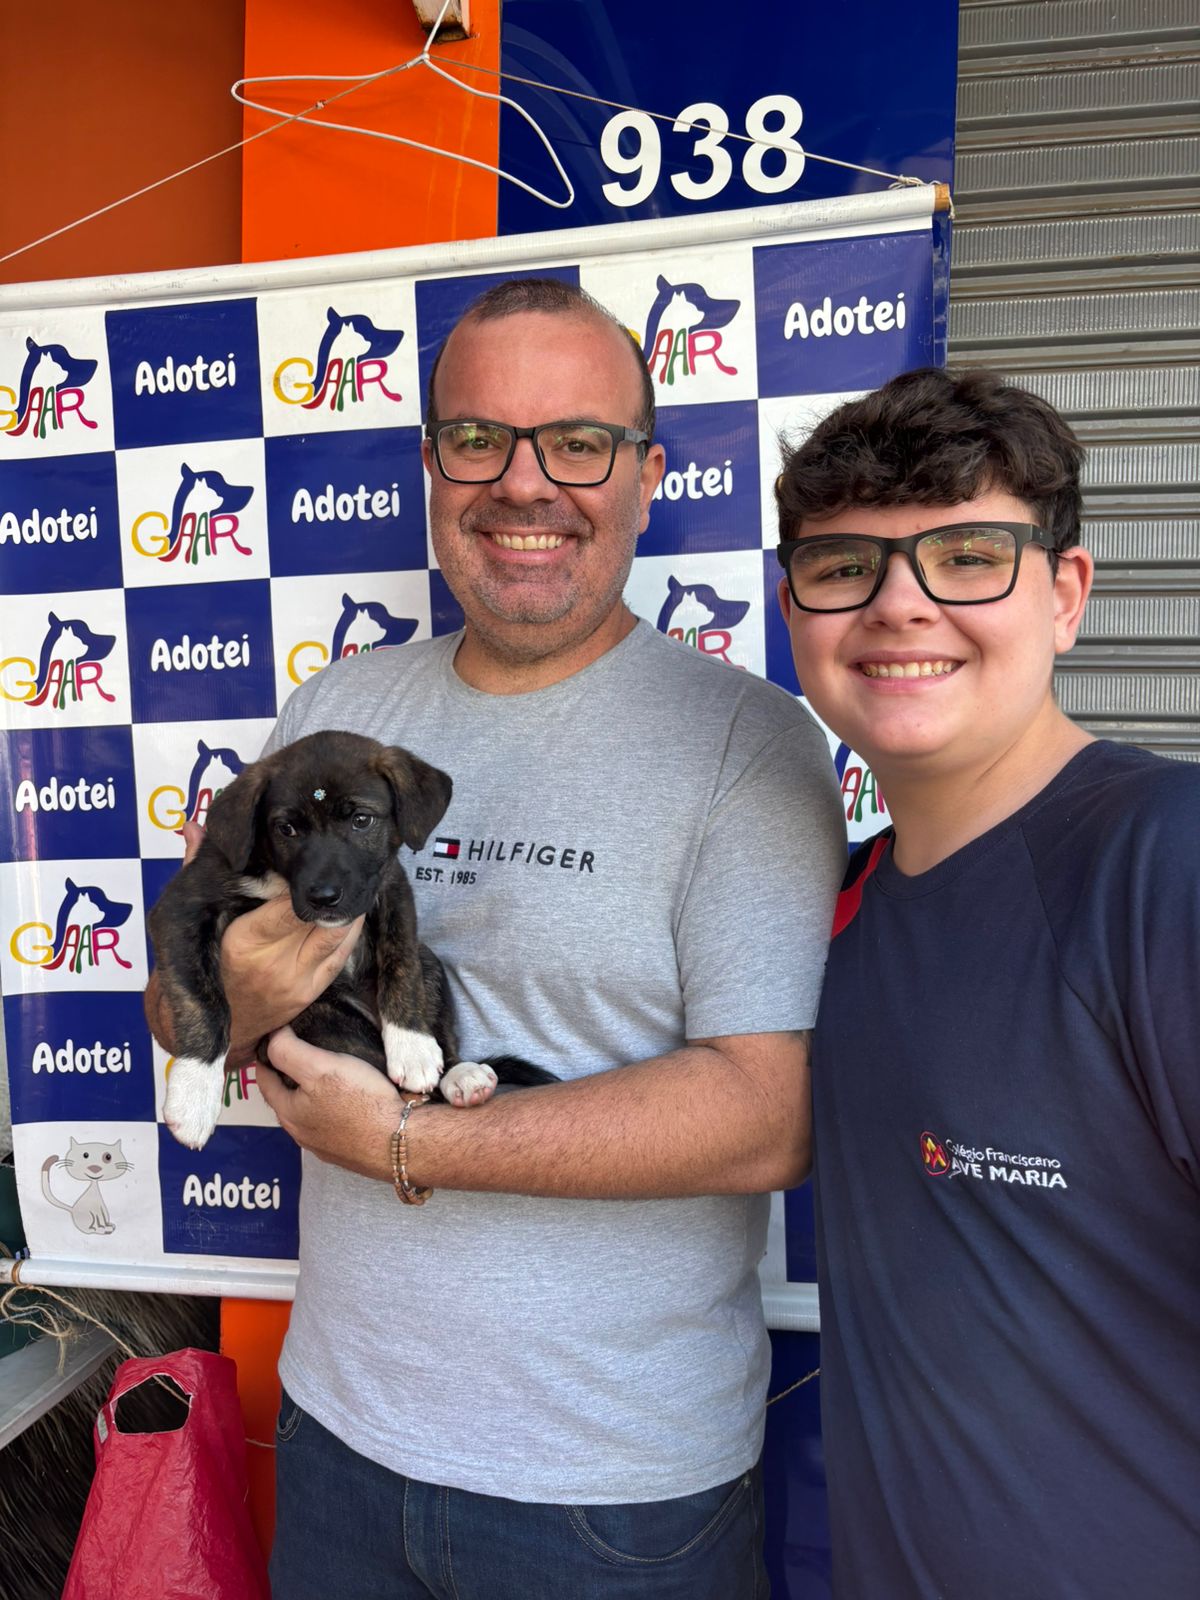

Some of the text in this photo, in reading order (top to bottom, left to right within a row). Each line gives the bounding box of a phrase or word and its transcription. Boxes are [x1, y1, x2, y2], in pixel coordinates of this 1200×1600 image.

[600, 94, 806, 207] 938
[784, 292, 906, 340] Adotei
[135, 353, 236, 395] Adotei
[628, 328, 738, 386] AAR
[273, 357, 403, 412] GAAR
[651, 460, 733, 501] otei
[291, 483, 400, 523] Adotei
[0, 506, 98, 544] Adotei
[131, 511, 253, 565] GAAR
[151, 634, 250, 672] Adotei
[0, 657, 116, 710] GAAR
[15, 777, 116, 812] Adotei
[415, 867, 477, 885] EST. 1985
[468, 840, 595, 873] HILFIGER
[9, 922, 133, 974] GAAR
[32, 1040, 132, 1074] Adotei
[948, 1157, 1068, 1188] AVE MARIA
[985, 1148, 1061, 1168] Franciscano
[182, 1173, 280, 1210] Adotei
